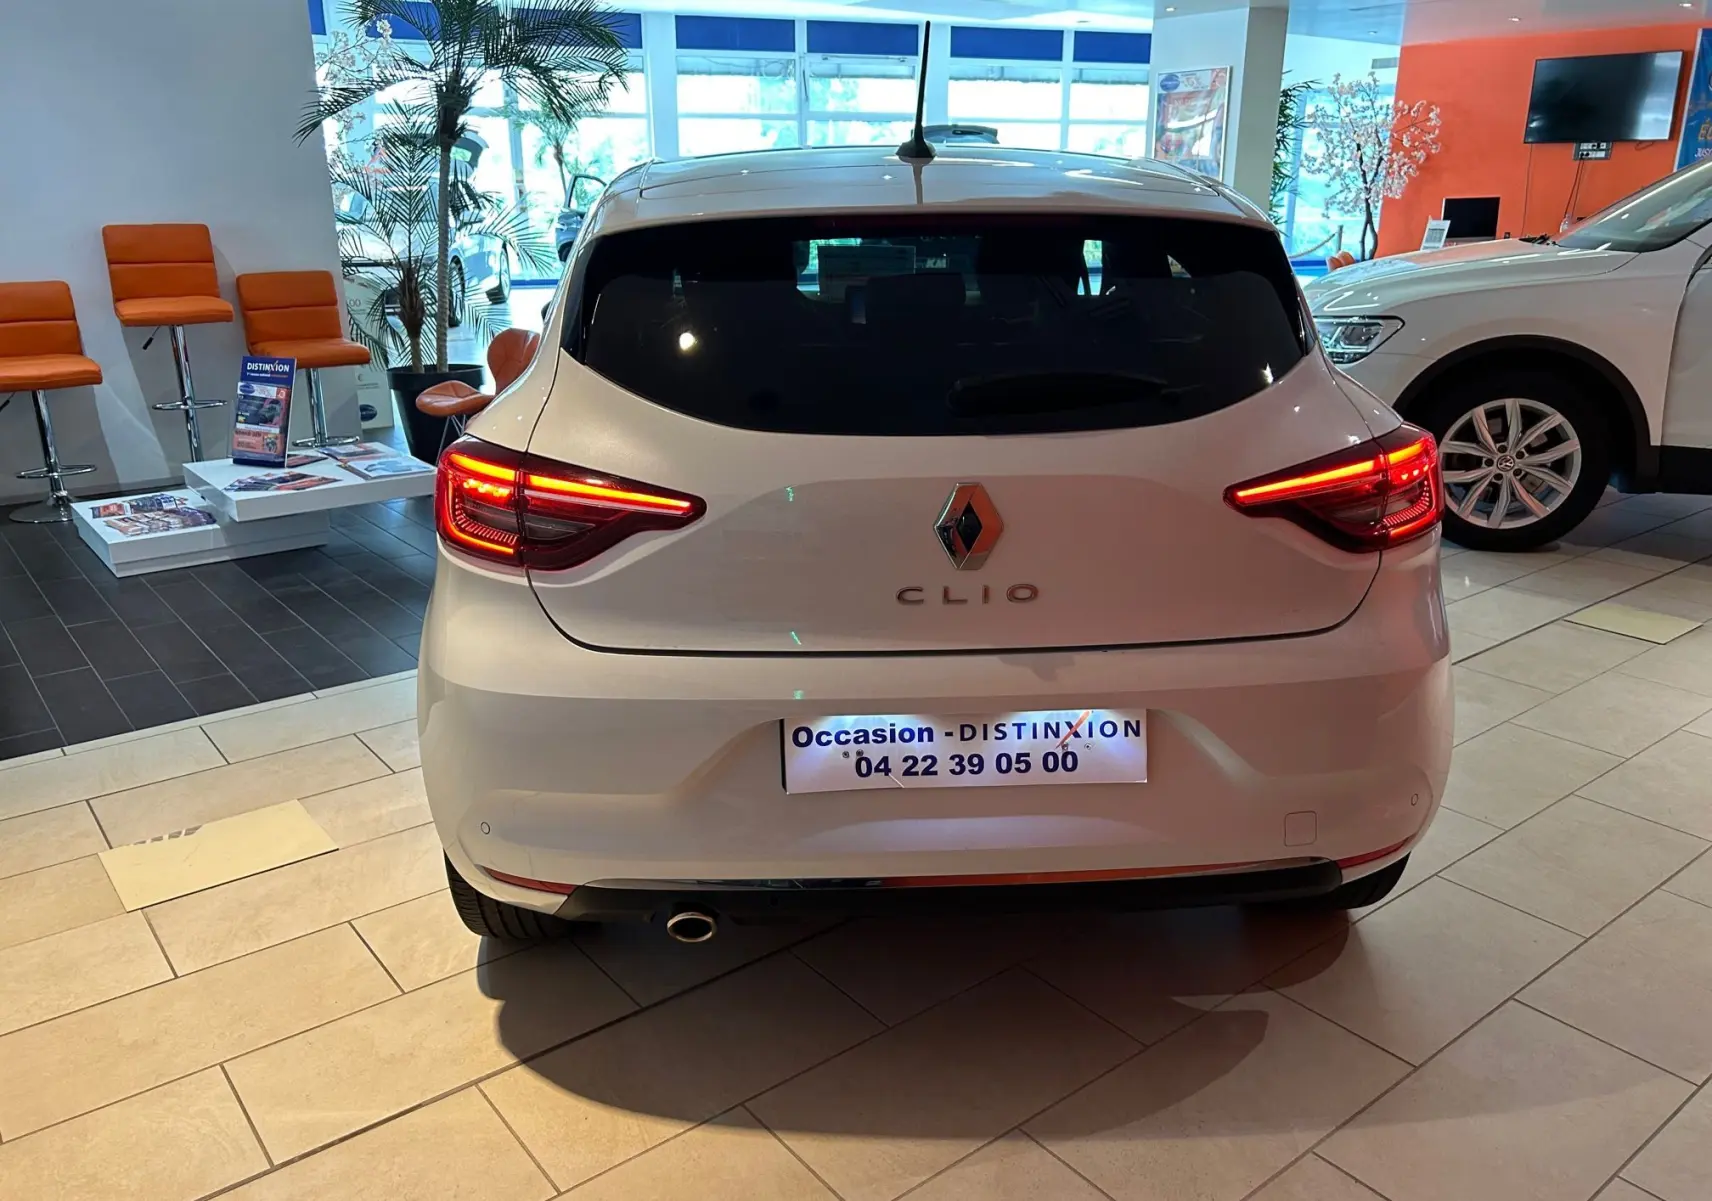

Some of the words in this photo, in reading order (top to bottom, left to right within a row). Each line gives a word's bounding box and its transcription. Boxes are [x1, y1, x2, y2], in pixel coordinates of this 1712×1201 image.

[246, 361, 290, 373] DISTINXION
[896, 584, 1039, 605] CLIO
[792, 722, 934, 748] Occasion
[855, 756, 892, 778] 04
[902, 754, 938, 776] 22
[949, 753, 985, 776] 39
[995, 752, 1031, 774] 05
[1042, 751, 1079, 773] 00
